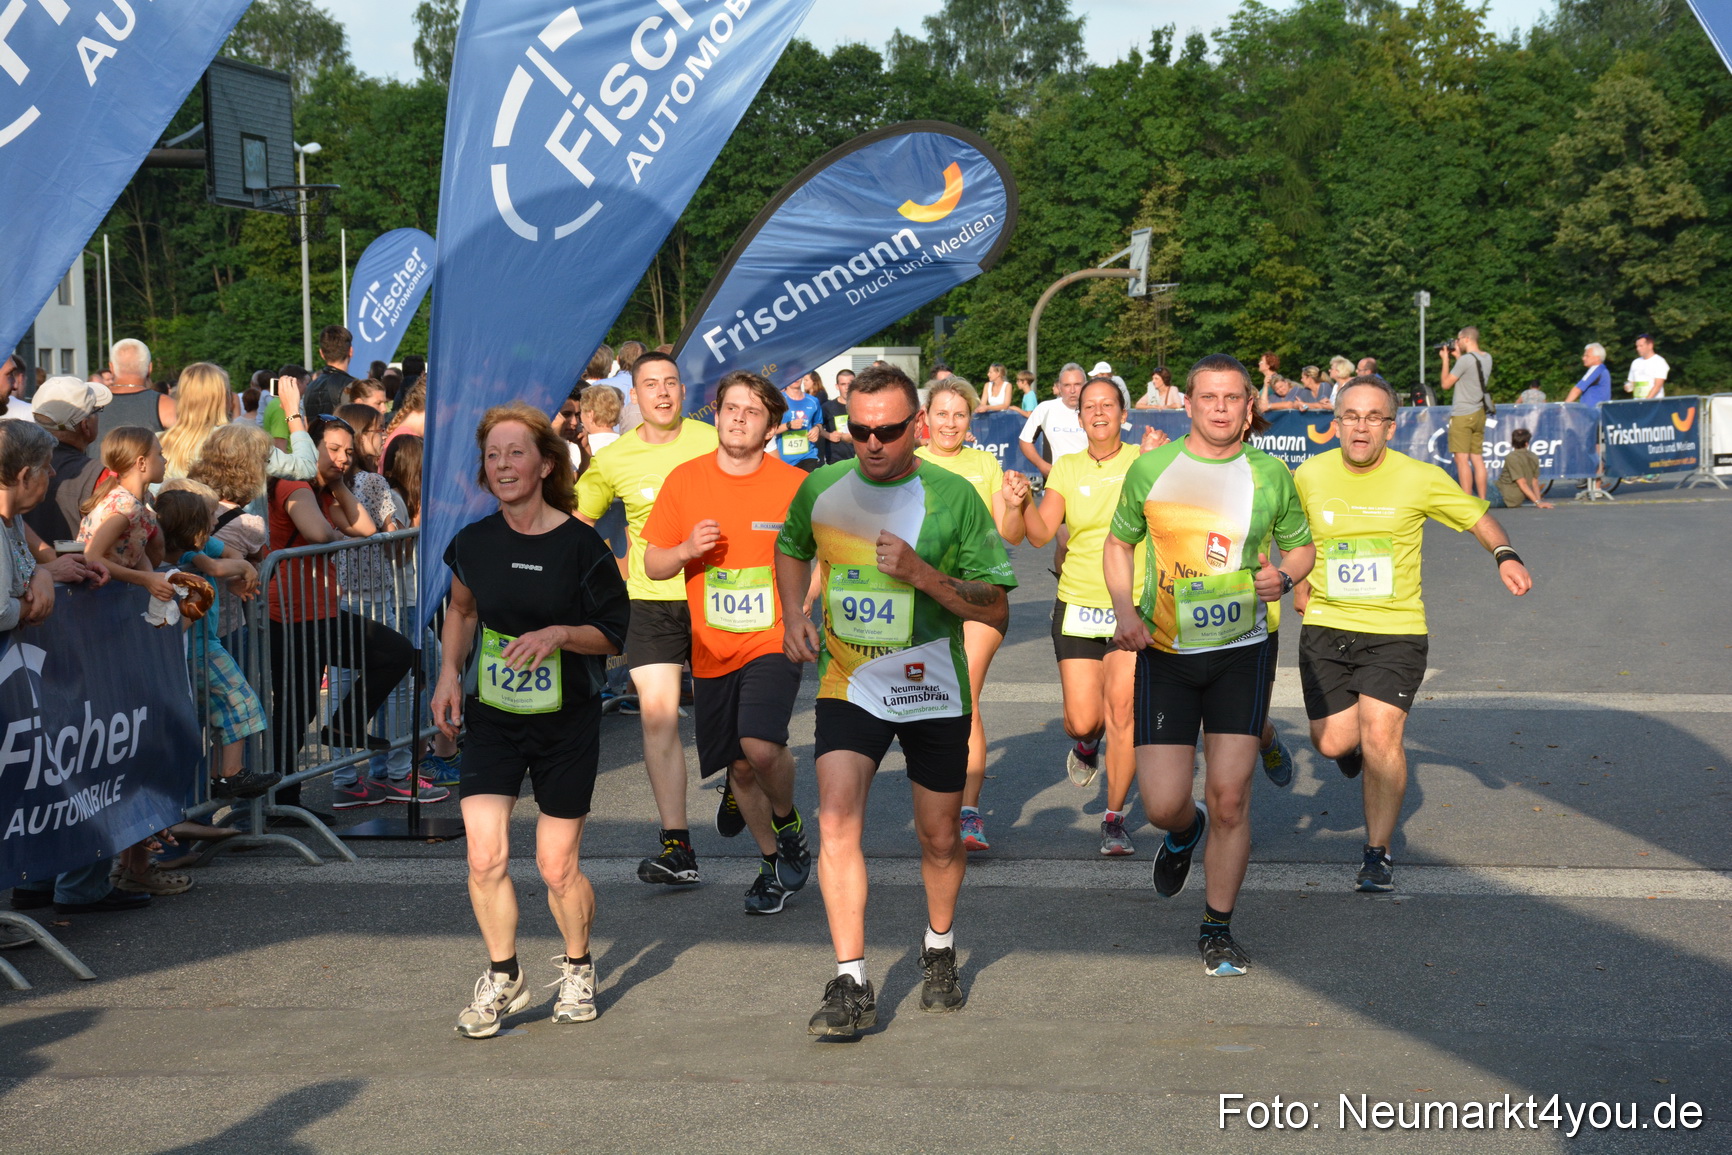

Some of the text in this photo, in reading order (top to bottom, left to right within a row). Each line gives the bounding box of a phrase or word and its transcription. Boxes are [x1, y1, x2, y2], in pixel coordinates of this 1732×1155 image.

[845, 213, 996, 306] Druck und Medien
[371, 246, 422, 329] Fischer
[389, 261, 428, 327] AUTOMOBILE
[702, 228, 922, 364] Frischmann
[788, 439, 804, 449] 457
[1606, 422, 1676, 446] Frischmann
[1648, 443, 1664, 455] Druck
[1337, 562, 1378, 584] 621
[711, 592, 764, 615] 1041
[842, 596, 895, 624] 994
[1079, 606, 1116, 625] 608
[1193, 601, 1241, 629] 990
[487, 662, 552, 693] 1228
[883, 691, 949, 707] Lammsbräu
[0, 700, 148, 790] Fischer
[3, 773, 126, 841] AUTOMOBILE
